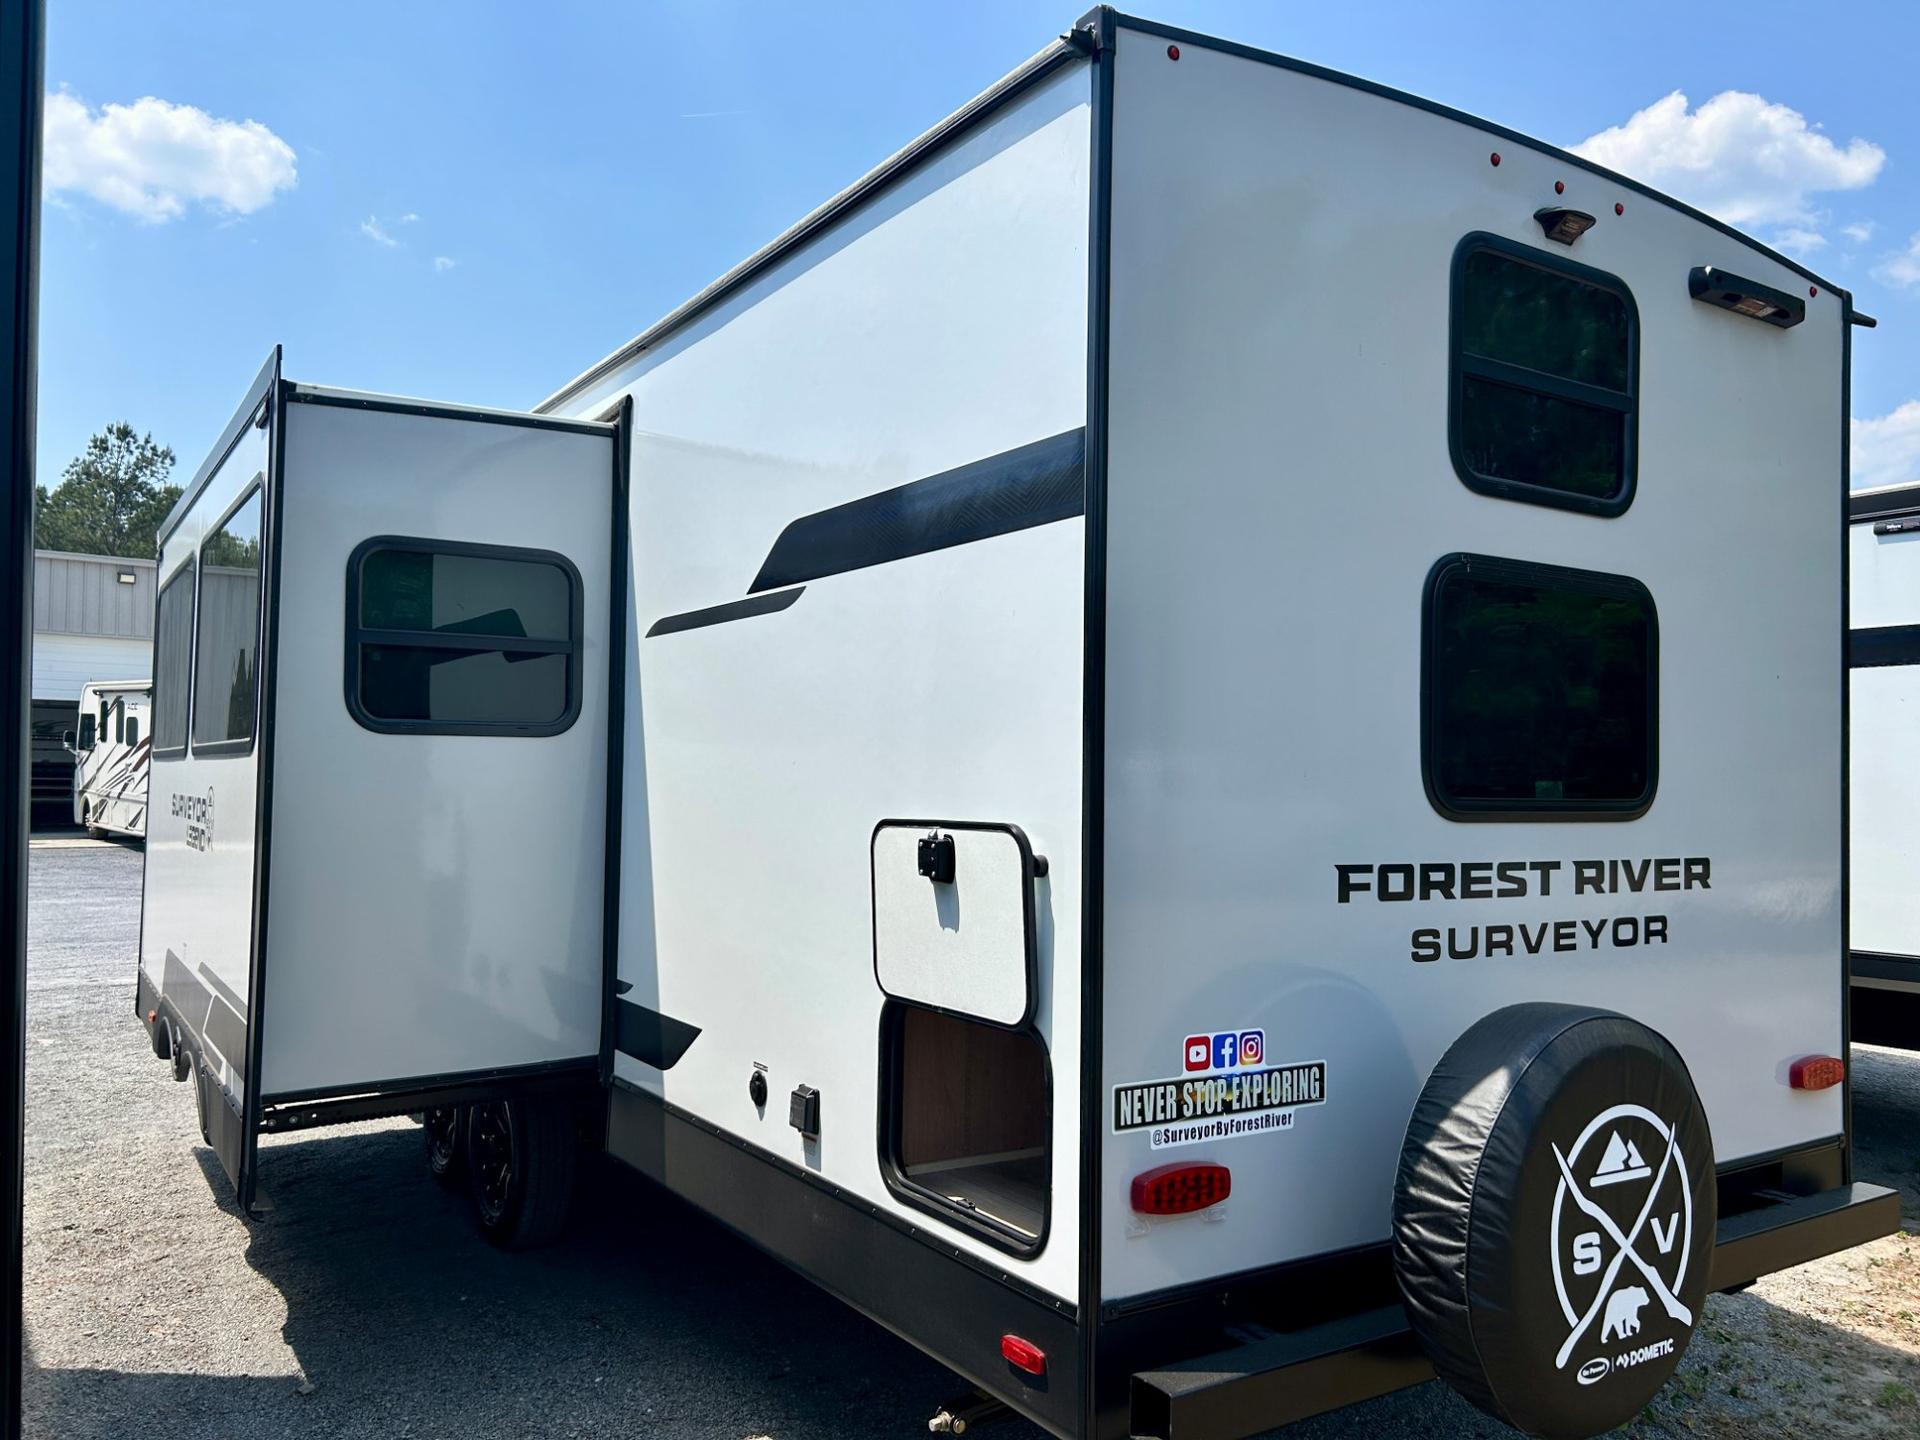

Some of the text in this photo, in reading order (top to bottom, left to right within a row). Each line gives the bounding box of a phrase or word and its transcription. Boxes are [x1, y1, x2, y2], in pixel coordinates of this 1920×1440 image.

[172, 793, 206, 823] SURVEYOR
[1333, 857, 1711, 903] FOREST RIVER
[1411, 915, 1668, 962] SURVEYOR
[1120, 1066, 1320, 1127] NEVER STOP EXPLORING
[1152, 1112, 1293, 1146] @SurveyorByForestRiver
[1629, 1338, 1674, 1366] DOMETIC
